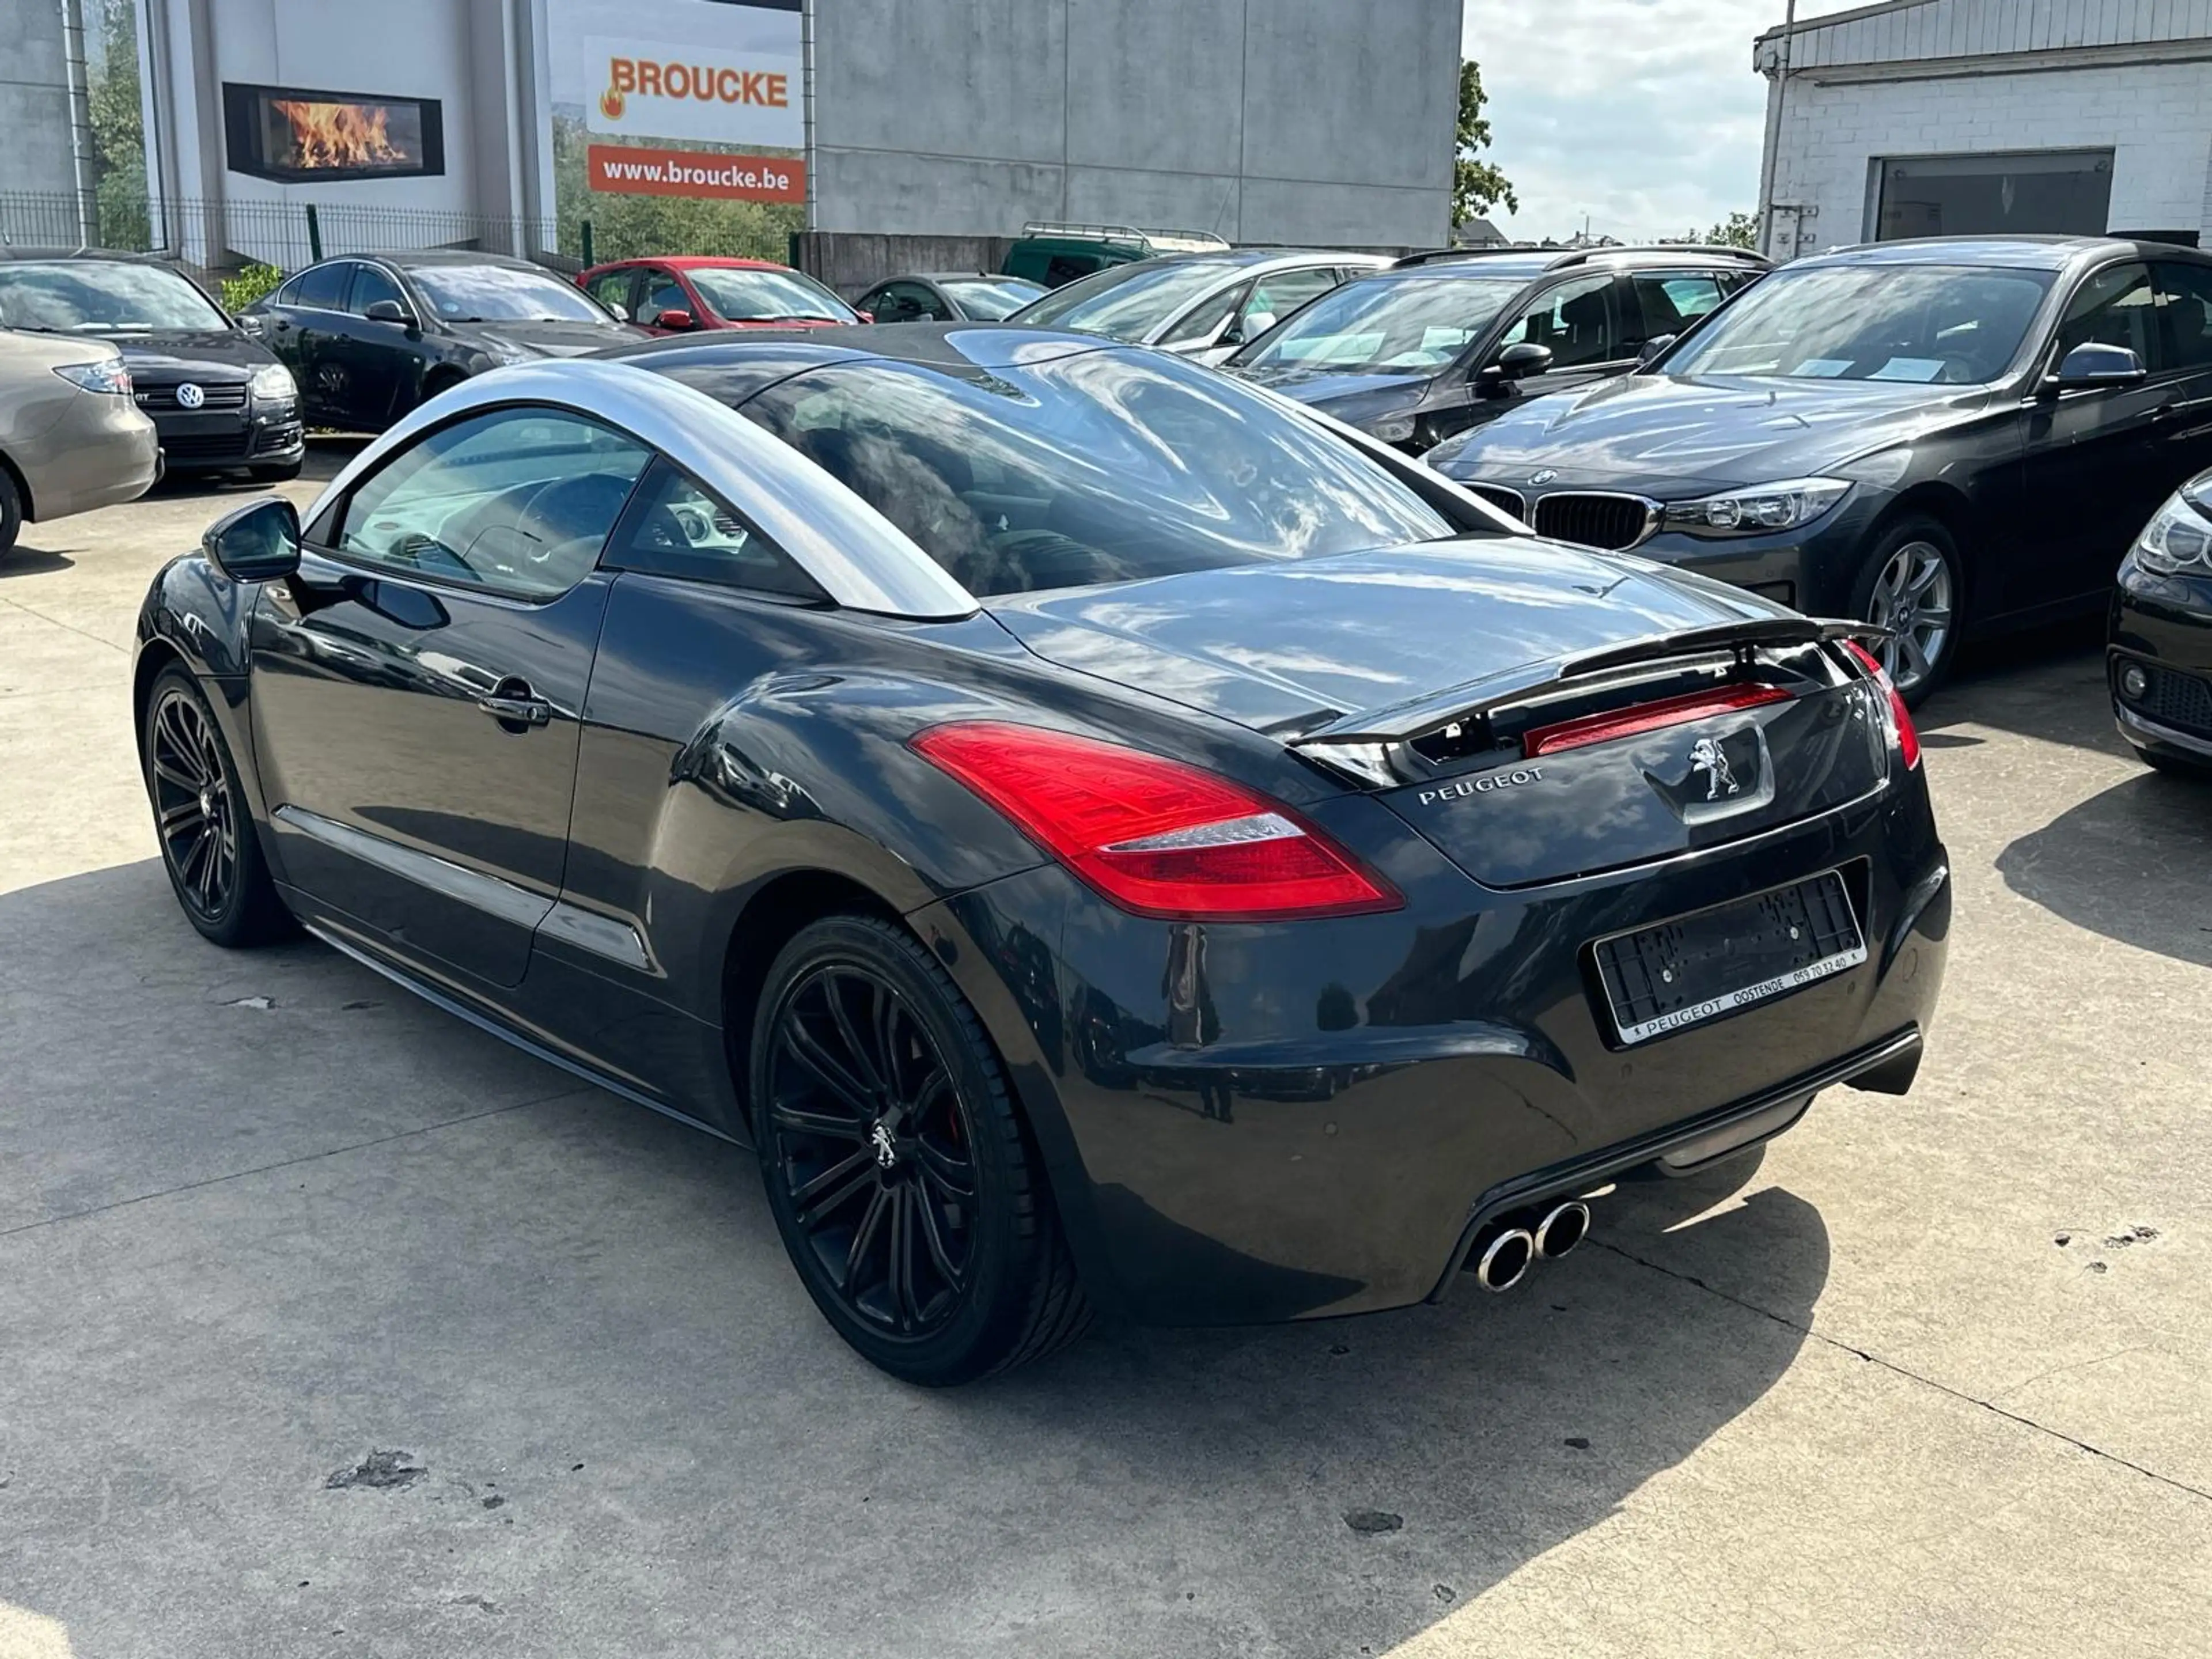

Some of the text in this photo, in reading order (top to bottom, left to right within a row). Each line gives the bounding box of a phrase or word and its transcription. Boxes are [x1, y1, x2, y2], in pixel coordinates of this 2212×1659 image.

[611, 57, 788, 108] BROUCKE
[603, 160, 789, 190] www.broucke.be
[1418, 767, 1543, 805] PEUGEOT
[1647, 1000, 1722, 1034] PEUGEOT
[1733, 979, 1785, 1004] OOSTENDE
